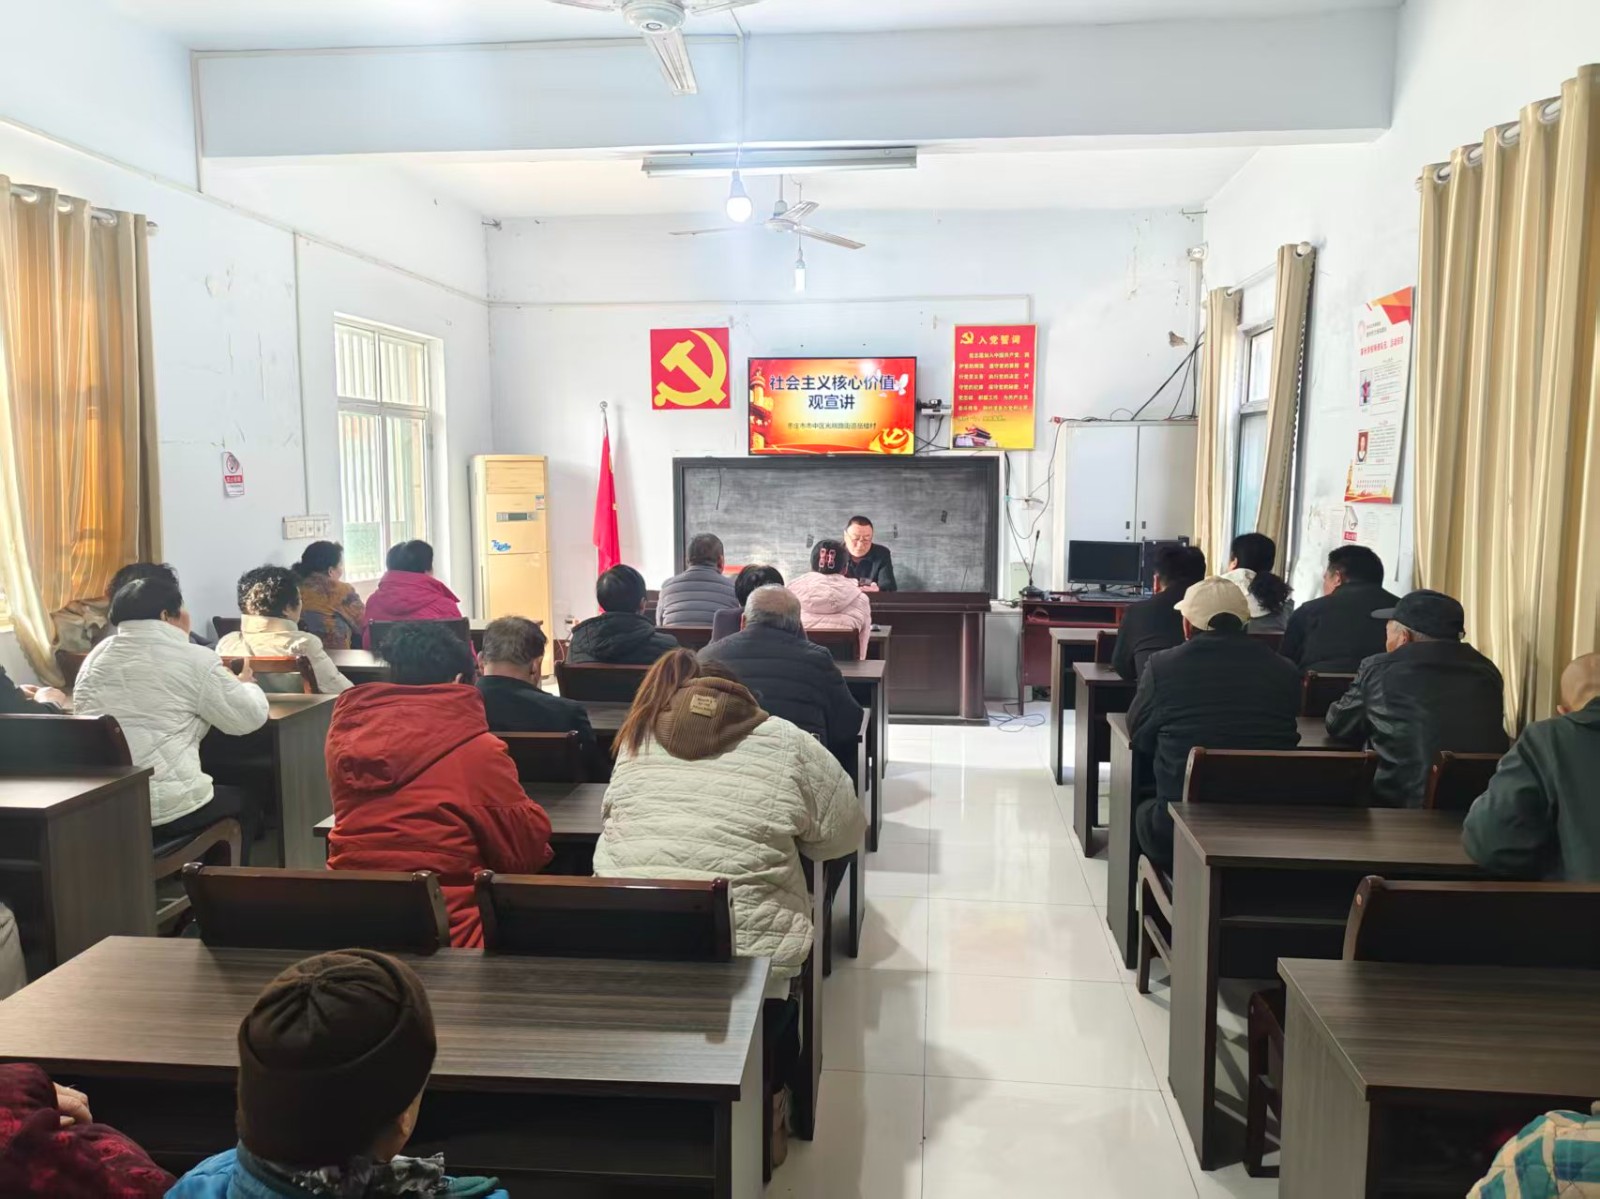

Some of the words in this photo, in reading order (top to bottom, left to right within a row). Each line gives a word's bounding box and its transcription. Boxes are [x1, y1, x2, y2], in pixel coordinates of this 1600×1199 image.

[769, 375, 895, 391] 社会主义核心价值
[808, 394, 855, 410] 观宣讲
